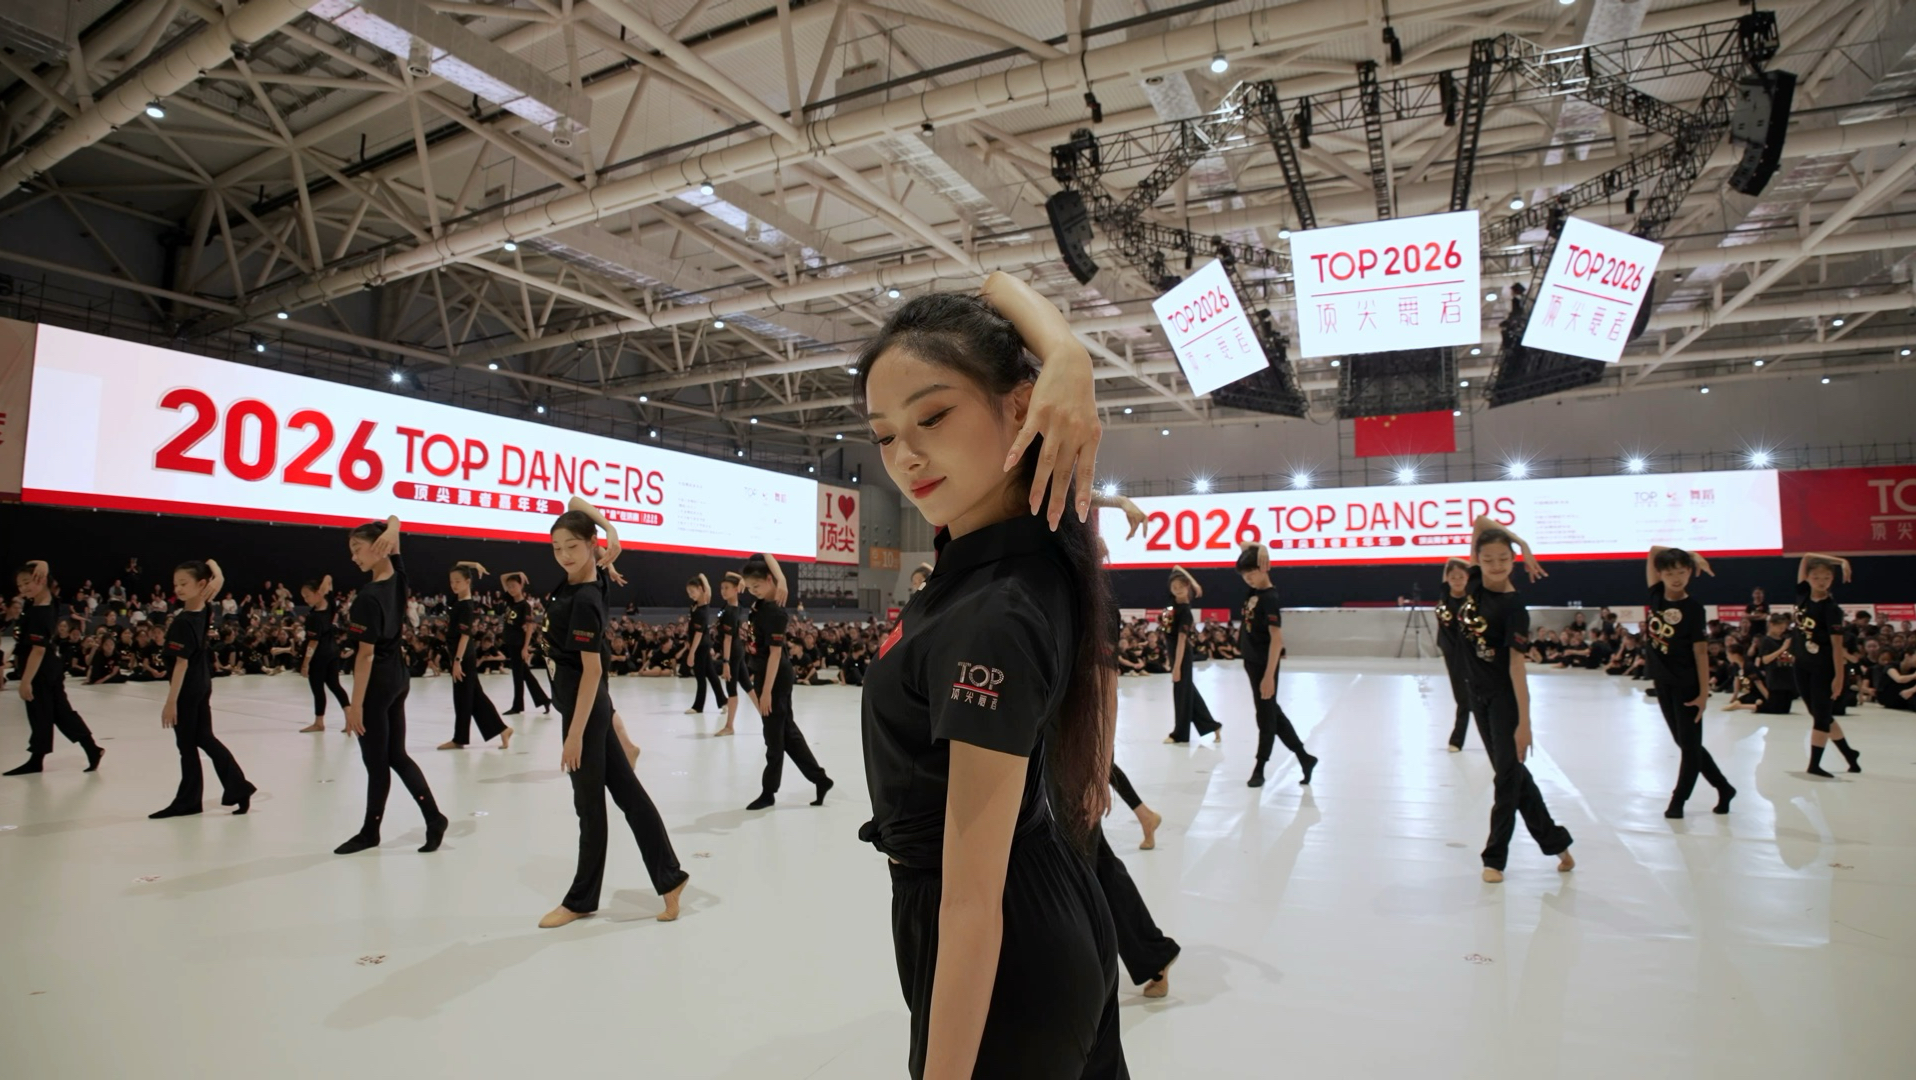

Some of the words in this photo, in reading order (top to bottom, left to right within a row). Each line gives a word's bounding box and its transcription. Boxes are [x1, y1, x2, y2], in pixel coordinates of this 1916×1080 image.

[153, 387, 384, 492] 2026
[396, 426, 489, 480] TOP
[499, 444, 664, 506] DANCERS
[825, 492, 833, 519] I
[819, 521, 855, 553] 顶尖
[1146, 507, 1261, 551] 2026
[1269, 504, 1336, 534] TOP
[957, 661, 1004, 690] TOP
